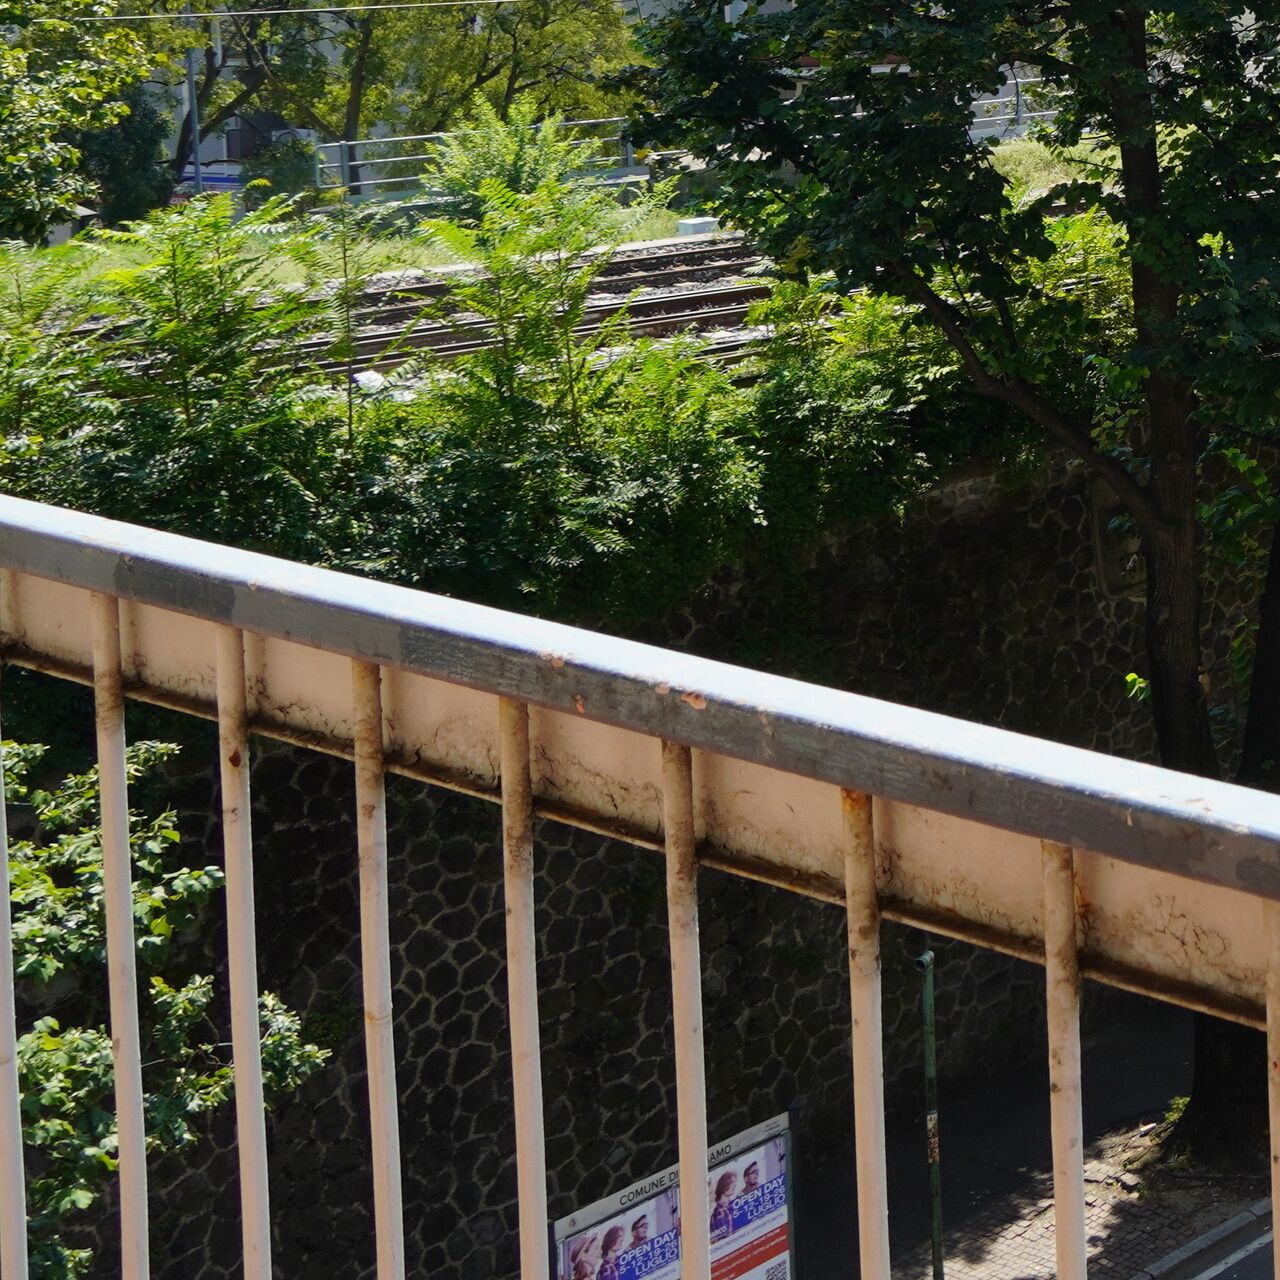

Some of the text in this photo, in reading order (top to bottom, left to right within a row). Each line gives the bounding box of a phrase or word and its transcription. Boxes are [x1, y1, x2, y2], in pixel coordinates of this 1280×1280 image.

[620, 1176, 666, 1206] COMUNE
[732, 1175, 785, 1209] OPEN DAY
[747, 1194, 786, 1220] LUGLIO
[619, 1229, 677, 1265] OPEN DAY
[635, 1248, 678, 1276] LUGLIO
